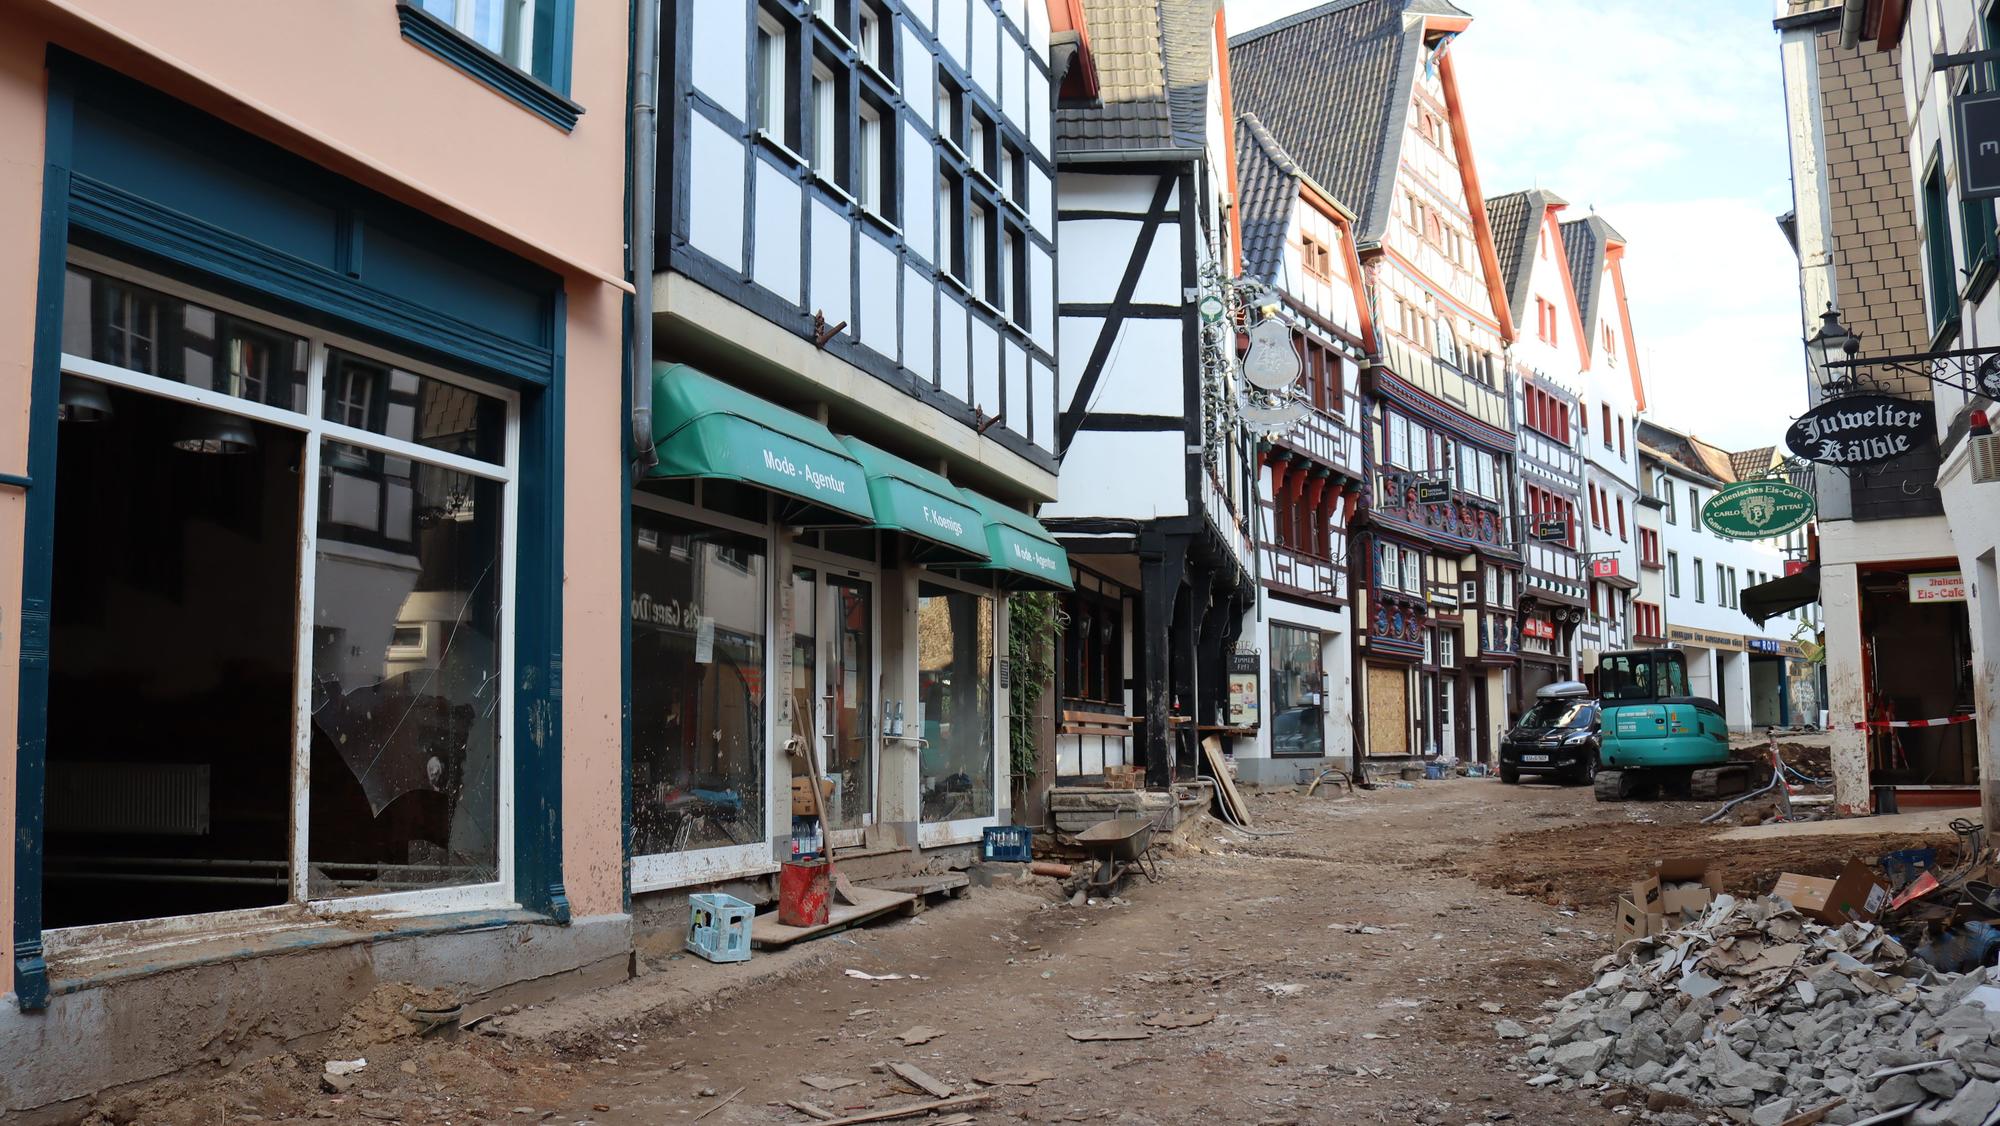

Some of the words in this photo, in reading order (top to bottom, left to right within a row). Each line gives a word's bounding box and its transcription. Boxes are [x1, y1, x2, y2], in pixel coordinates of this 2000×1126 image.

[1797, 405, 1921, 446] Juwelier
[1813, 433, 1910, 462] Kälble
[763, 449, 796, 476] Mode
[805, 464, 846, 494] Agentur
[1712, 486, 1763, 508] Italienisches
[1765, 485, 1803, 500] Eis-Café
[1713, 510, 1740, 518] CARLO
[1776, 503, 1804, 511] PITTAU
[923, 505, 932, 524] F.
[931, 509, 963, 536] Koenigs
[1013, 543, 1033, 562] Mode
[1035, 551, 1057, 570] Agentur
